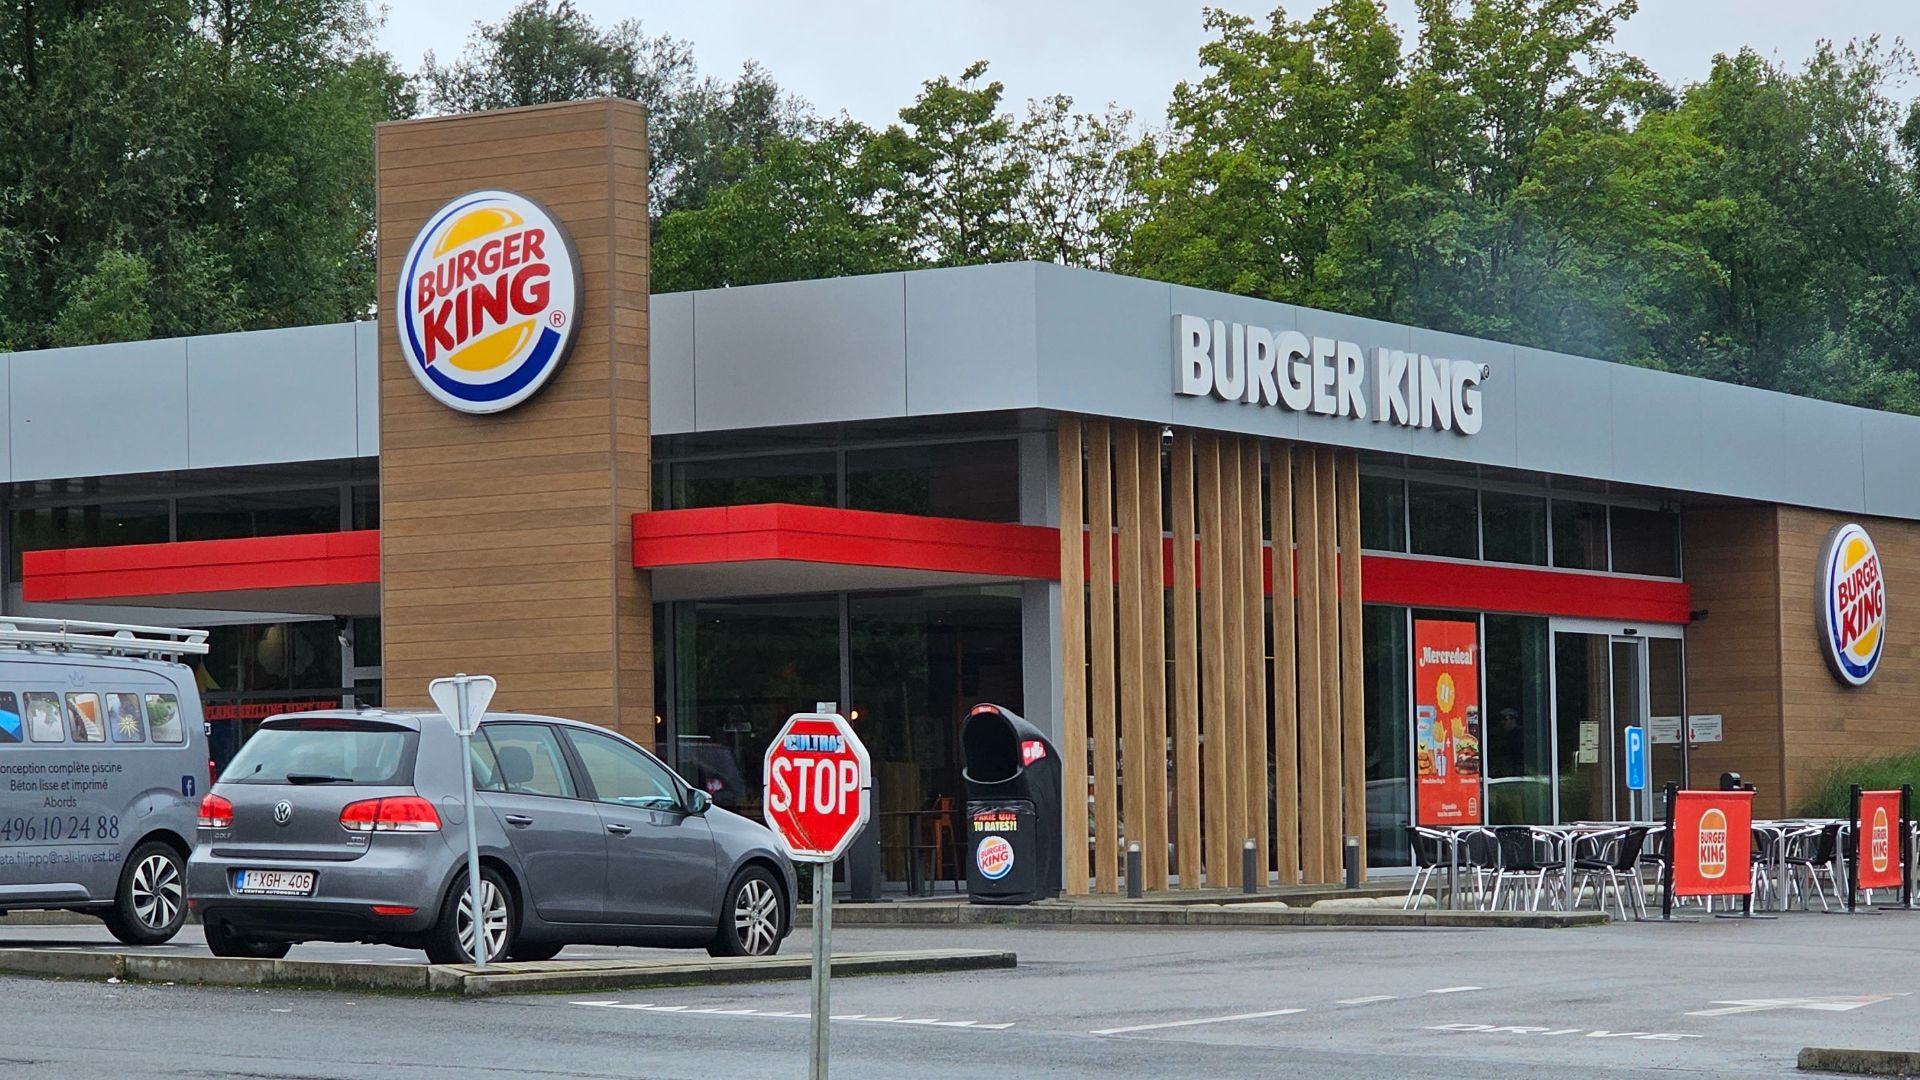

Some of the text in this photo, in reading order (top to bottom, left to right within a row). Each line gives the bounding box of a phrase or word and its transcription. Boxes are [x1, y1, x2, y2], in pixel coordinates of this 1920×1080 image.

[418, 228, 545, 313] BURGER
[424, 263, 550, 366] KING
[1174, 314, 1482, 436] BURGER KING
[1838, 554, 1878, 613] BURGER
[1841, 580, 1882, 651] KING
[1419, 646, 1473, 667] Mercredeal
[1631, 732, 1641, 764] P
[48, 761, 90, 776] complète
[92, 761, 122, 777] piscine
[10, 778, 108, 792] Béton lisse et imprimé
[770, 756, 859, 815] STOP
[43, 796, 77, 808] Abords
[42, 816, 62, 840] 10
[67, 816, 91, 839] 24
[97, 815, 119, 839] 88
[974, 821, 983, 832] TU
[1700, 831, 1725, 844] BURGER
[981, 844, 1007, 859] BURGER
[982, 851, 1009, 869] KING
[1700, 844, 1725, 863] KING
[1423, 1022, 1704, 1042] DRIVE
